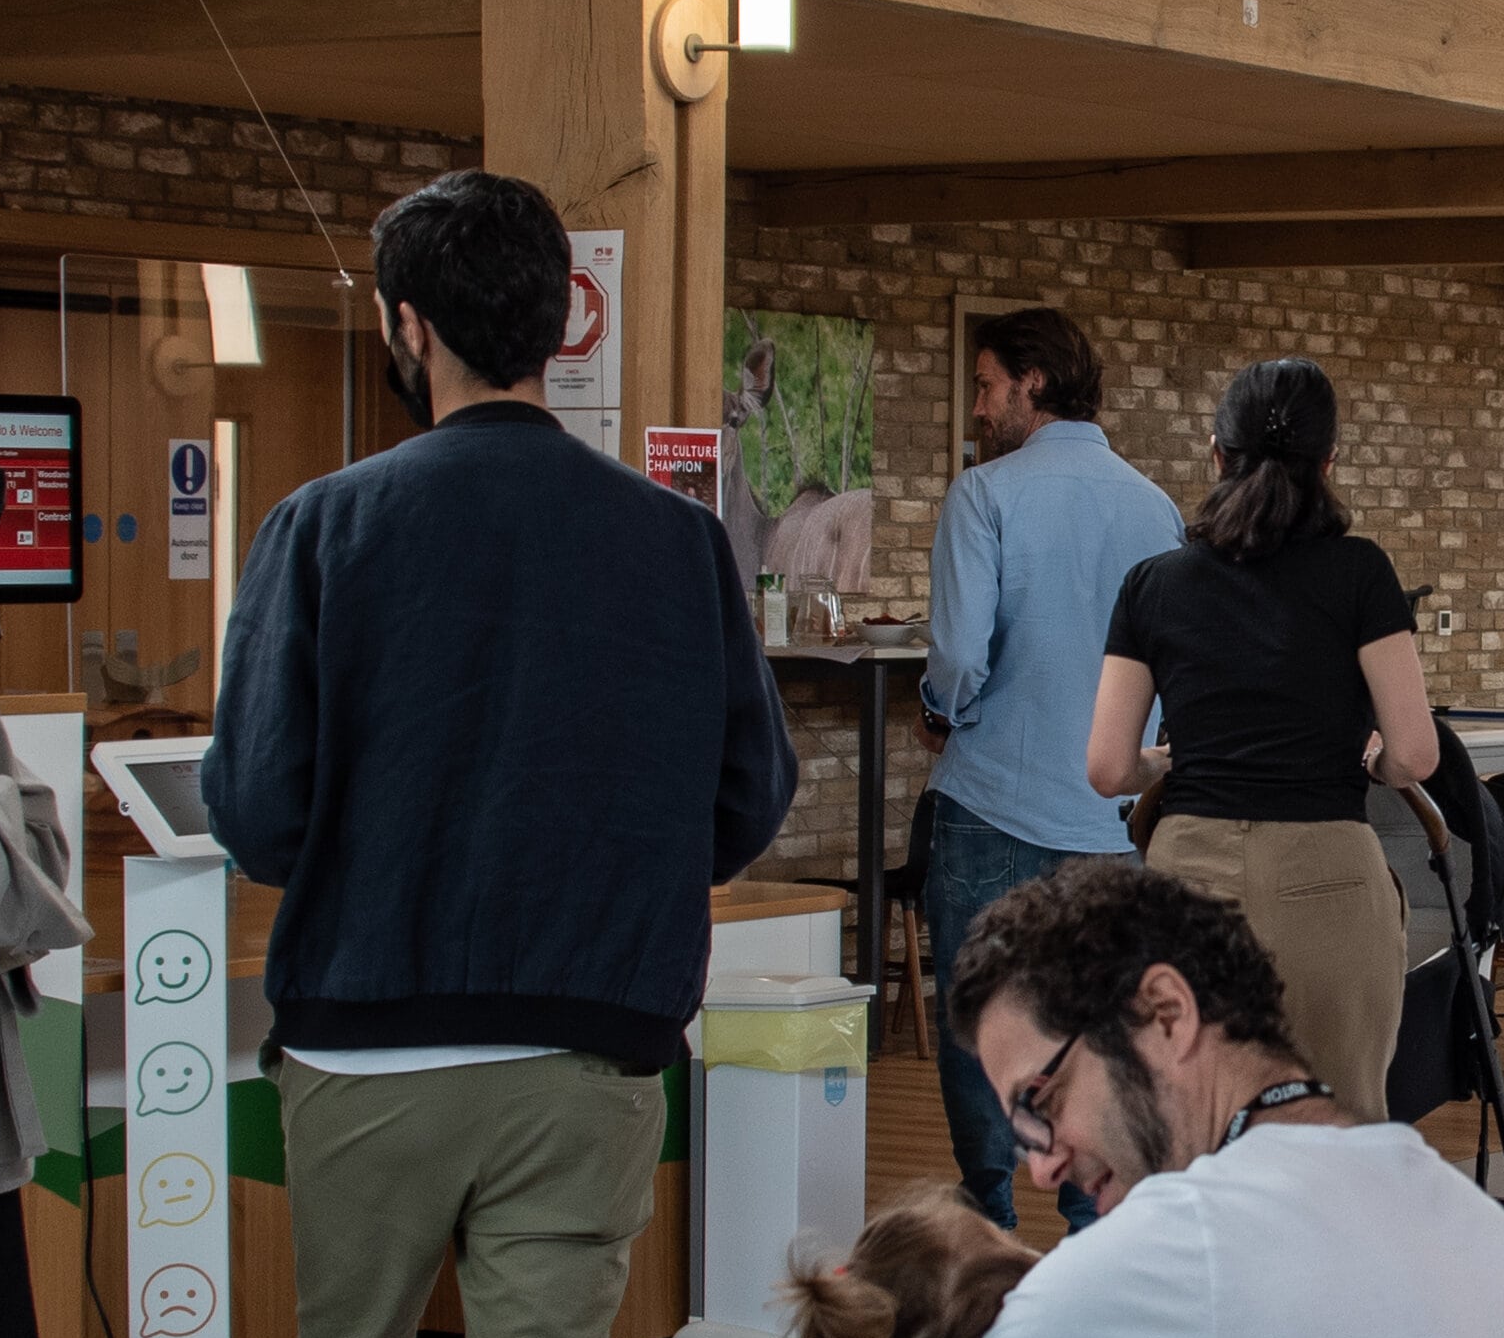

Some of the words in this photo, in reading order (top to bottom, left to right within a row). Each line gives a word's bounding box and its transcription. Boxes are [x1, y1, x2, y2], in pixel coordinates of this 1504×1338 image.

[9, 426, 17, 436] &
[19, 425, 63, 437] Welcome
[648, 443, 669, 457] OUR
[672, 444, 718, 458] CULTURE
[648, 459, 702, 473] CHAMPION
[171, 539, 208, 547] Automatic
